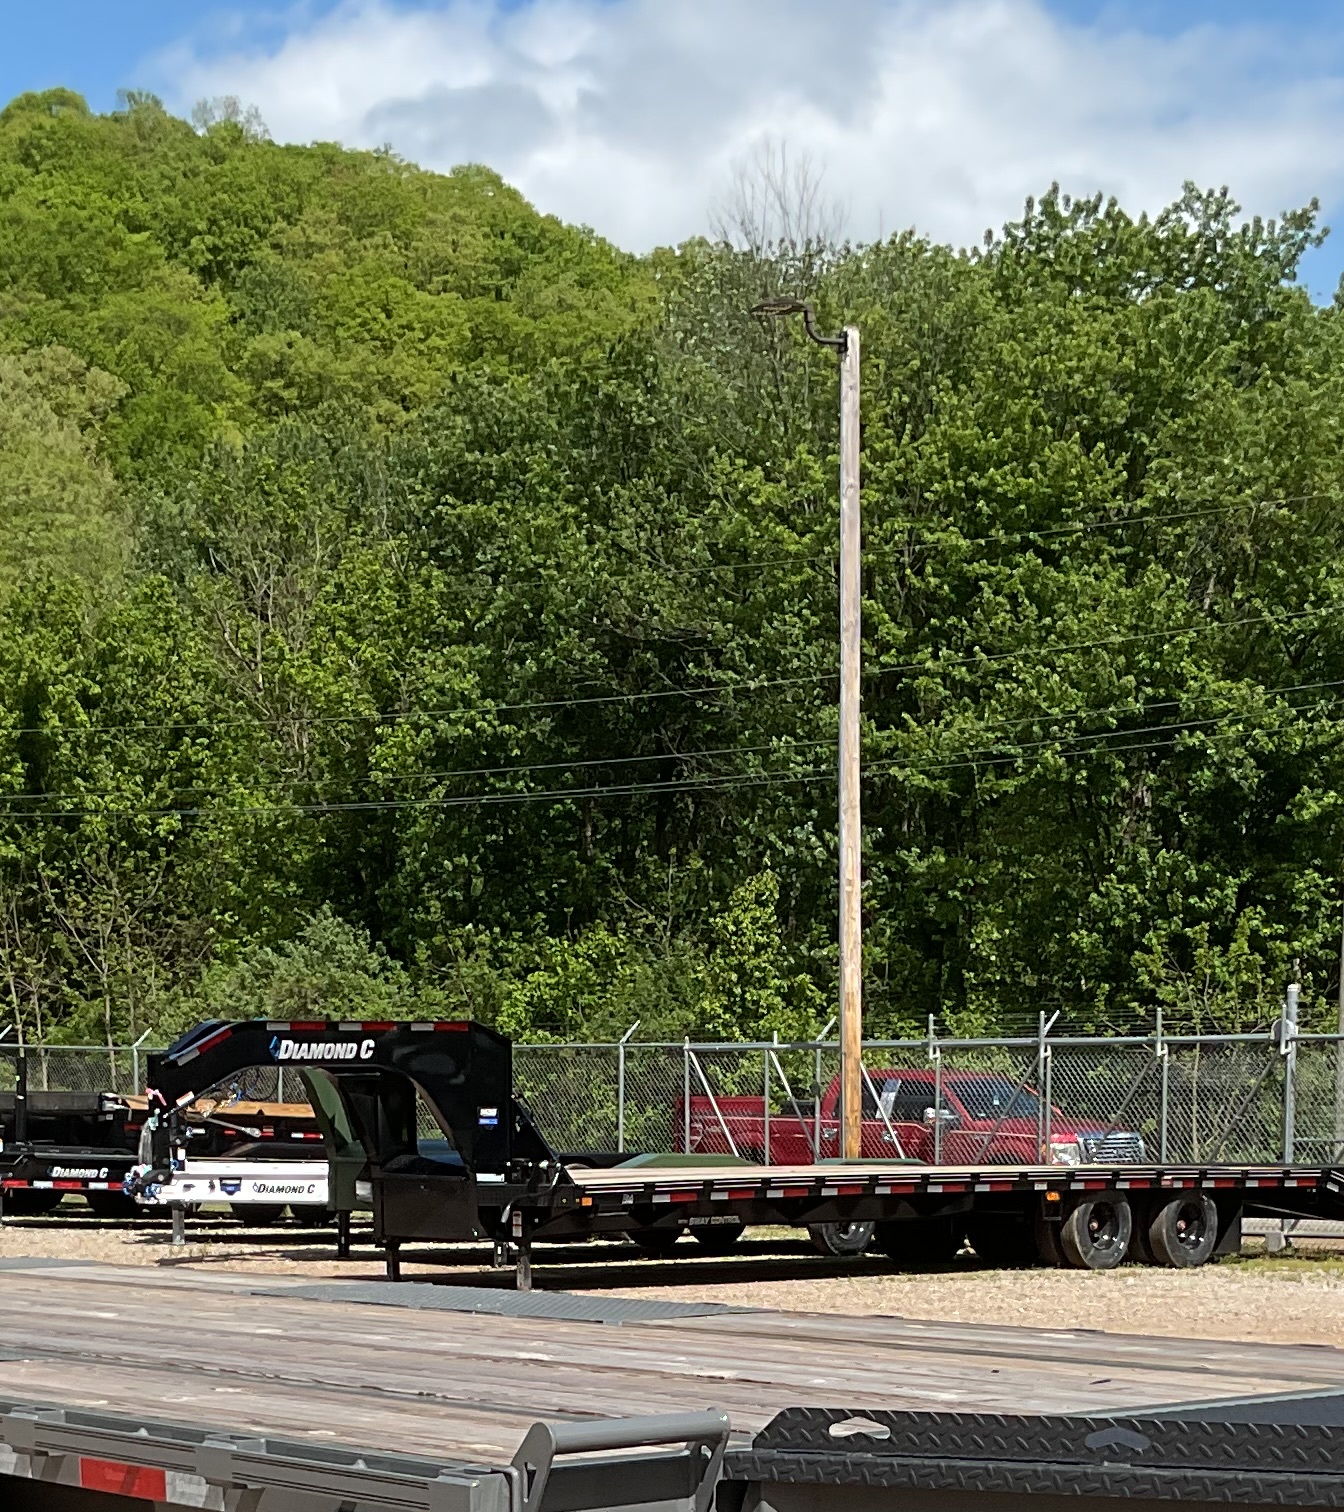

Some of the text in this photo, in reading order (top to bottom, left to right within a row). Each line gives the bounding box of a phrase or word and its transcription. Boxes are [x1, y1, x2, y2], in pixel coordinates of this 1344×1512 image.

[278, 1039, 376, 1060] DIAMOND C
[52, 1166, 109, 1179] DIAMOND C
[257, 1183, 316, 1194] DIAMOND C
